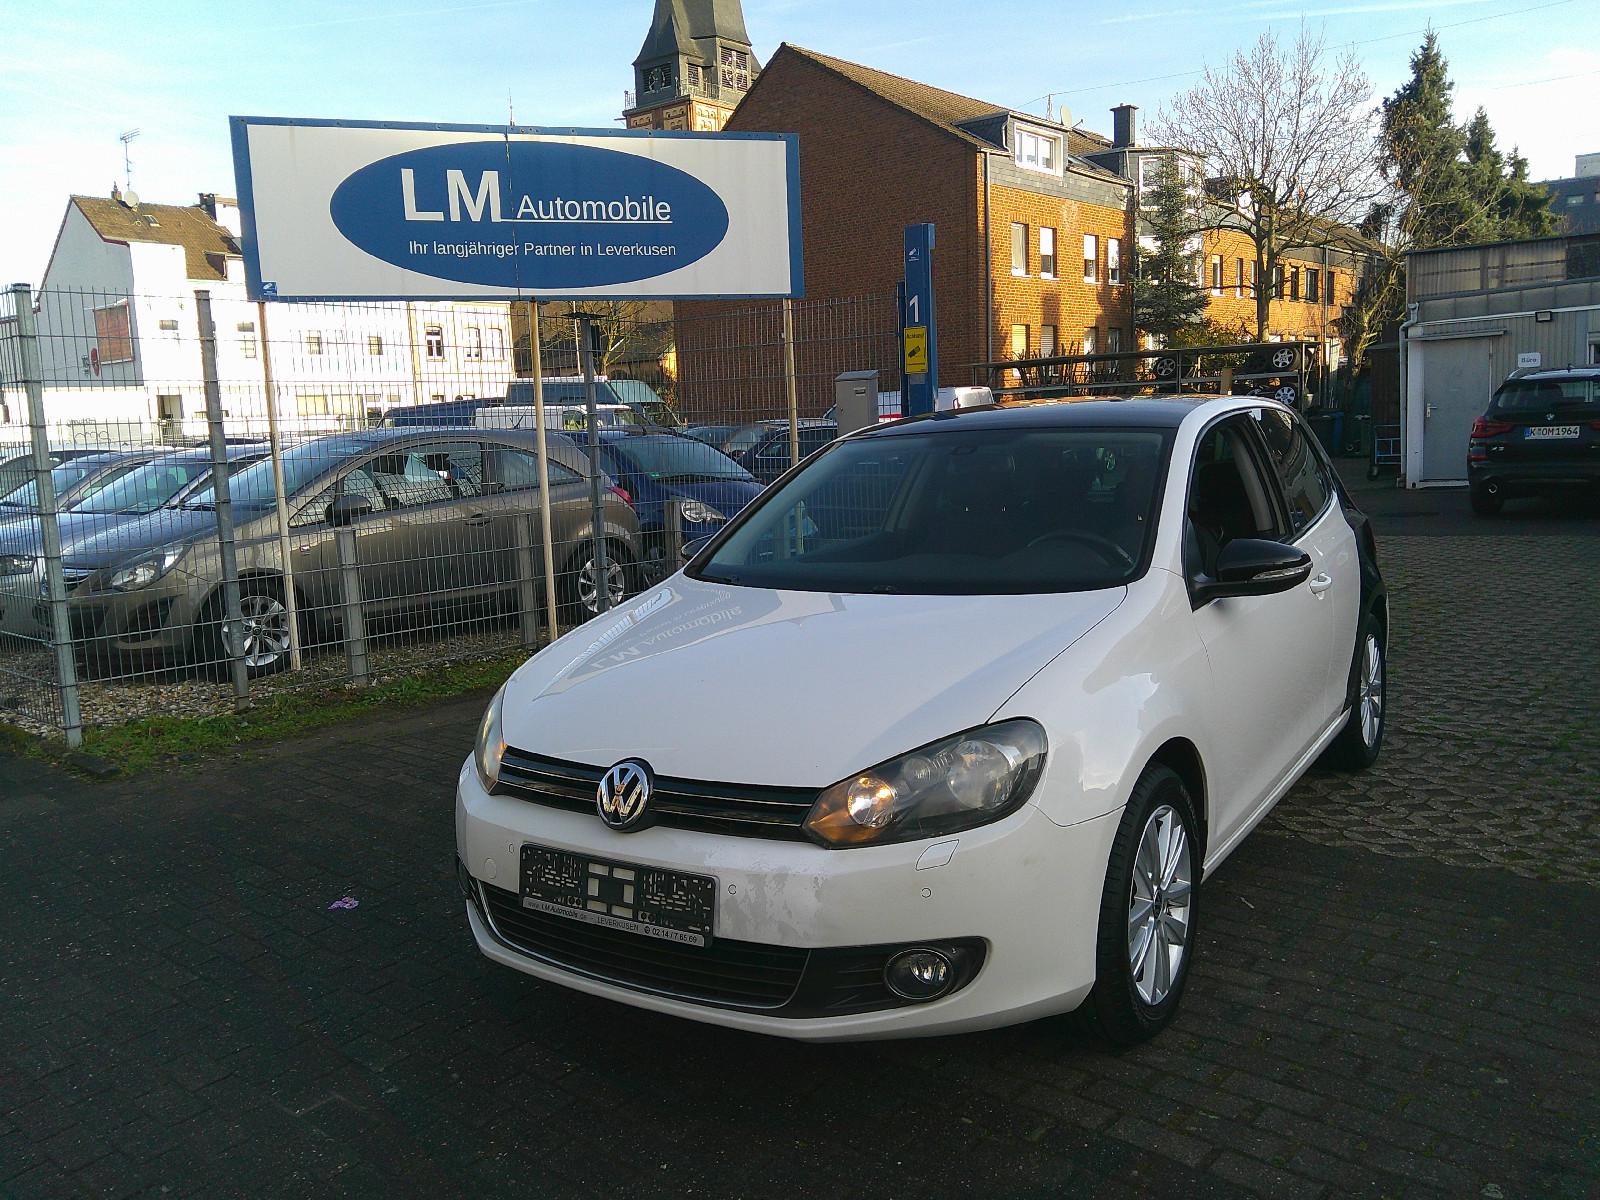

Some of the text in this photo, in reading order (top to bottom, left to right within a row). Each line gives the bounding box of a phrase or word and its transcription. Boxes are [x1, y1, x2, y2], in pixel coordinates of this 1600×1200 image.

[401, 168, 672, 223] LM Automobile
[409, 240, 676, 258] Ihr langjähriger Partner in Leverkusen
[909, 295, 919, 323] 1
[1555, 427, 1578, 436] 1964
